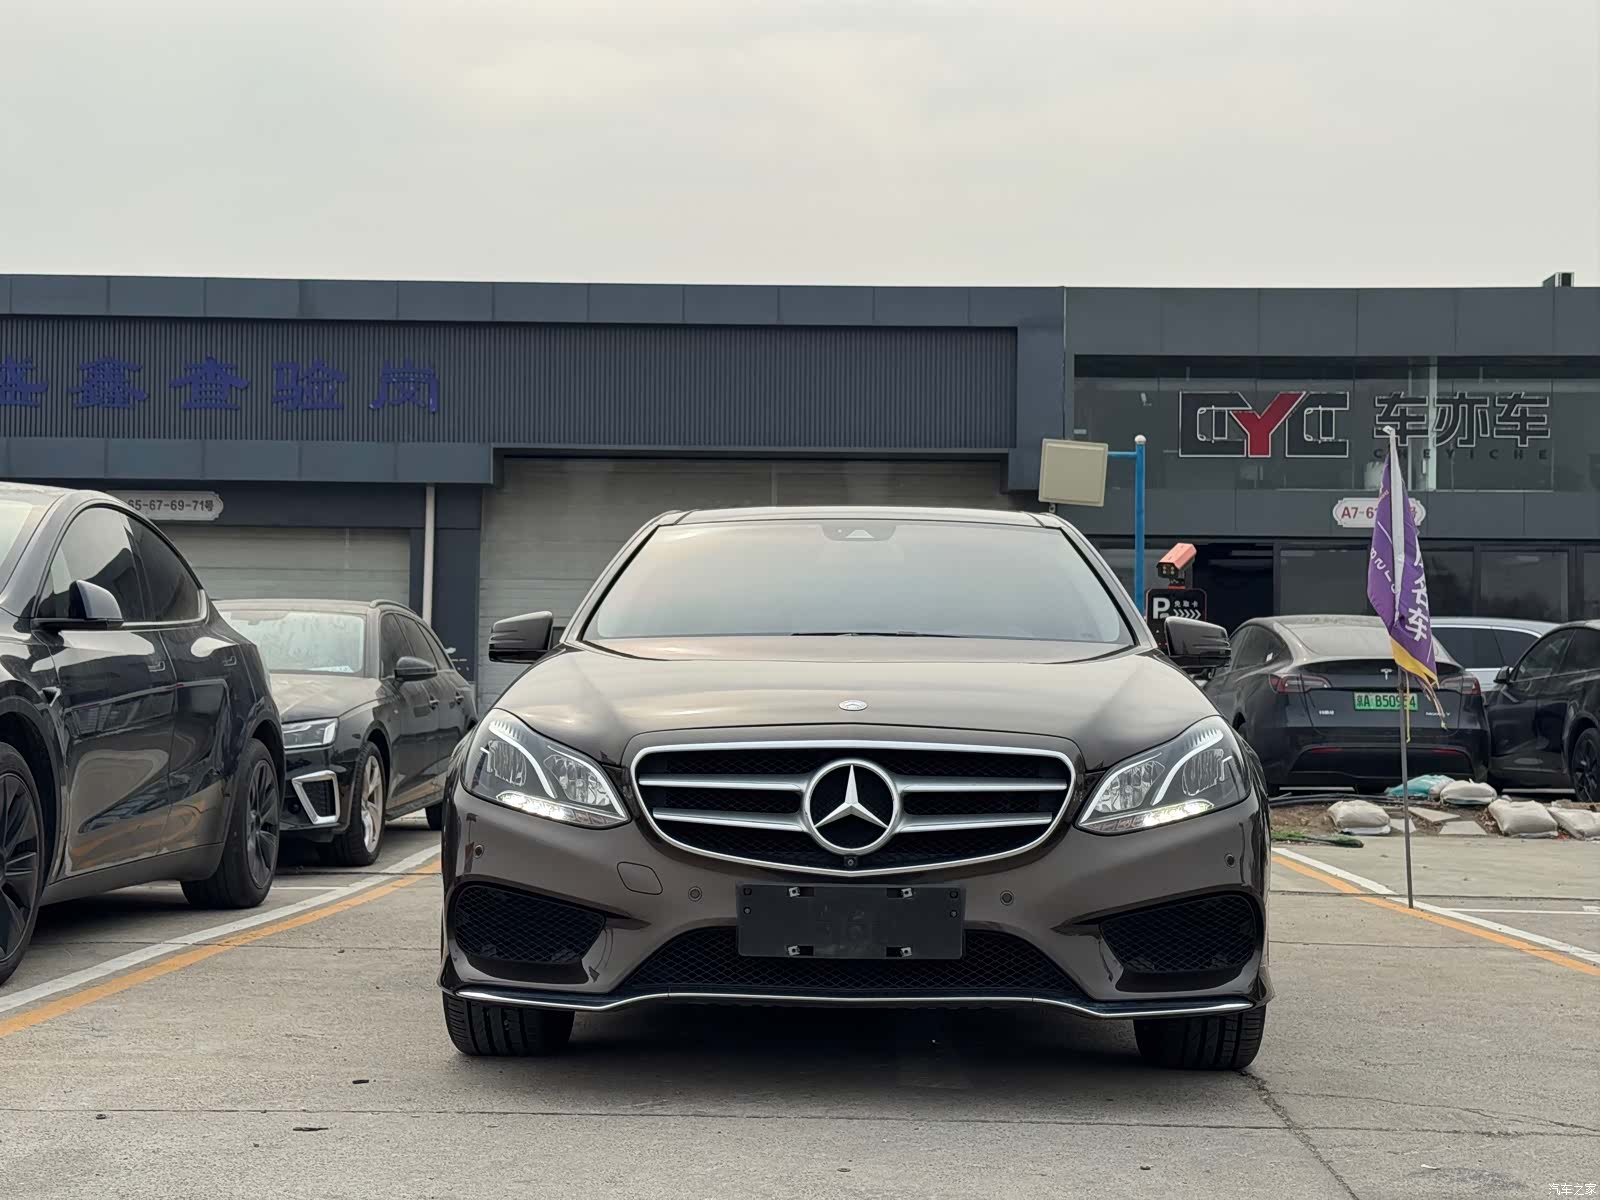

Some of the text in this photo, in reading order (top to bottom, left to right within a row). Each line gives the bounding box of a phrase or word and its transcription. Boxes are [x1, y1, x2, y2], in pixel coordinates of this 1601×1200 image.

[1179, 391, 1350, 457] CYC
[1374, 391, 1550, 447] 车亦车
[1152, 597, 1170, 619] P
